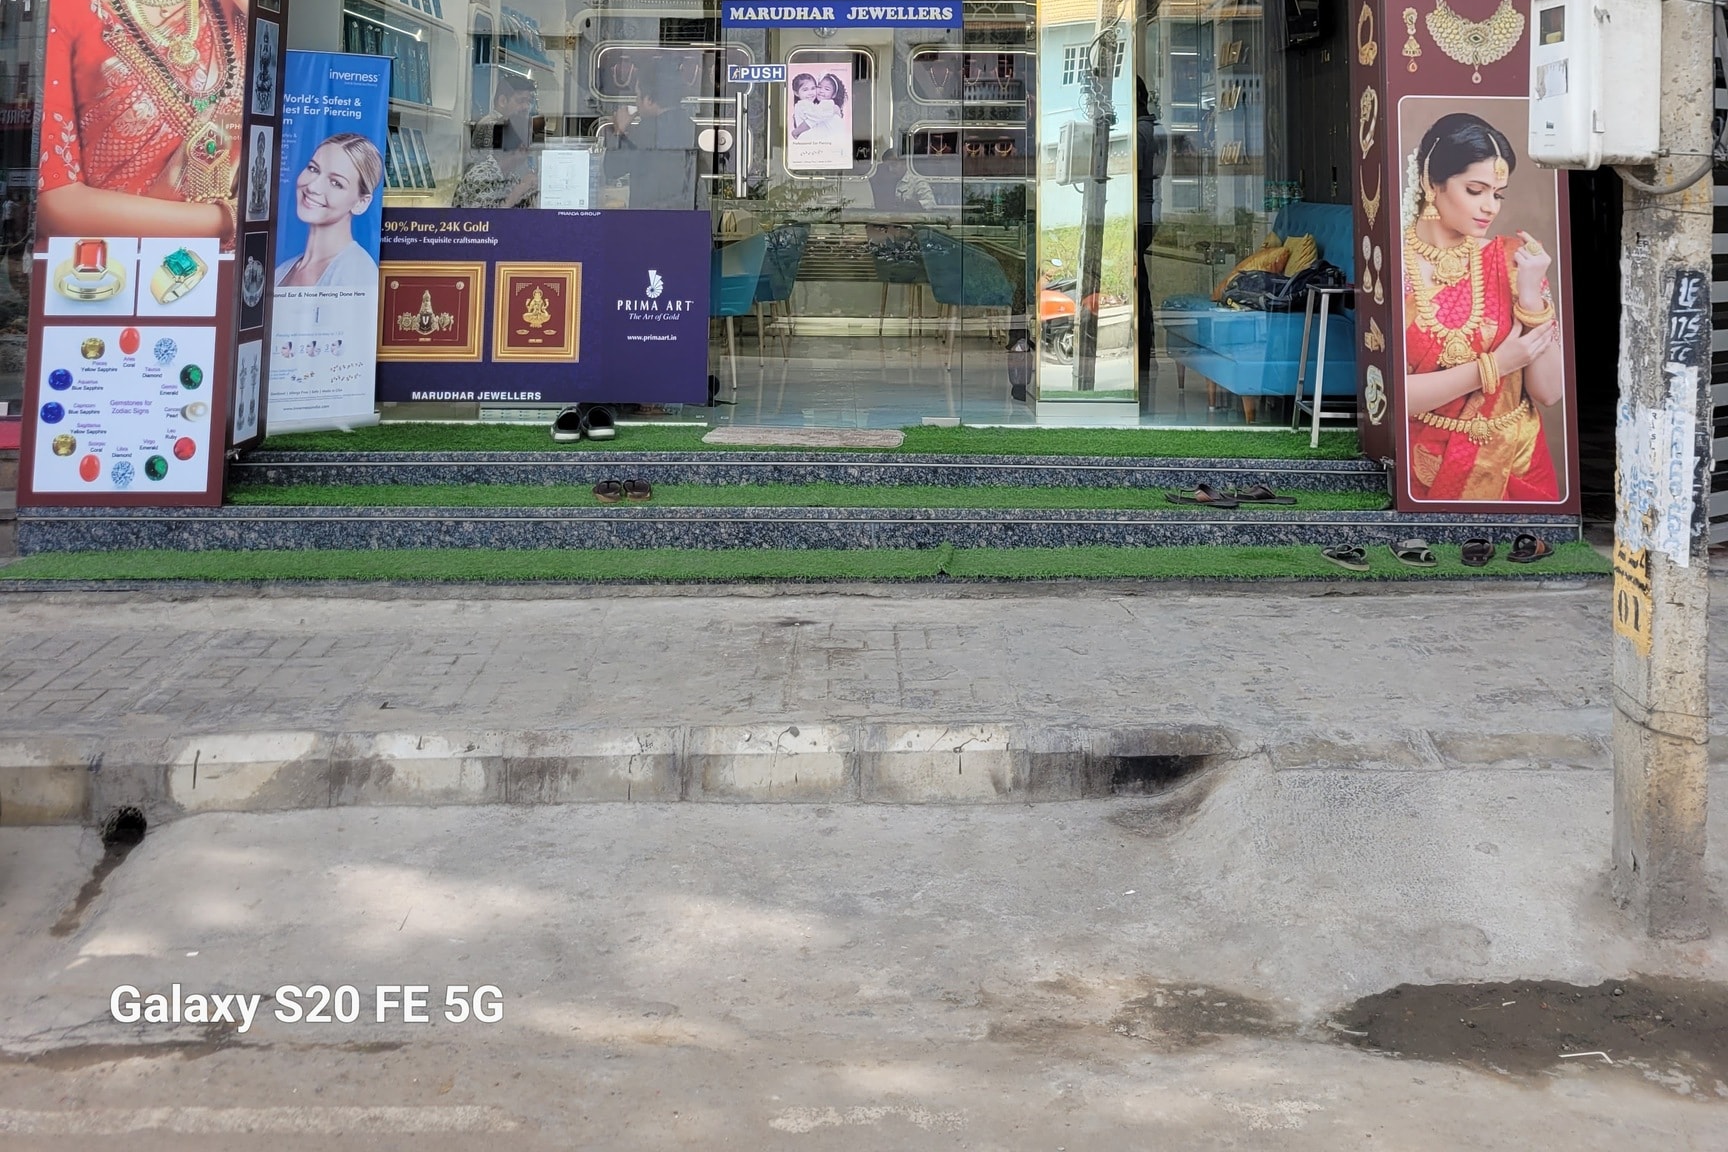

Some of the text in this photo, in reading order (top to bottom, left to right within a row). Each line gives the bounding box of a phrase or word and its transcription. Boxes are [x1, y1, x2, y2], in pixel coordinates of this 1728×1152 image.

[729, 7, 953, 20] MARUDHAR JEWELLERS
[329, 69, 378, 83] inverness
[741, 67, 782, 79] PUSH
[322, 96, 351, 106] Safest
[354, 98, 361, 107] &
[303, 106, 320, 115] Ear
[324, 107, 361, 119] Piercing
[411, 221, 438, 233] Pure,
[440, 221, 460, 232] 24K
[463, 221, 489, 232] Gold
[393, 236, 418, 244] designs
[423, 236, 451, 245] Exquisite
[453, 237, 499, 246] craftsmanship
[617, 300, 692, 311] PRIMA ART
[655, 313, 662, 321] of
[663, 313, 680, 321] Gold
[627, 334, 677, 342] www.primaart.in
[412, 391, 542, 400] MARUDHAR JEWELLERS
